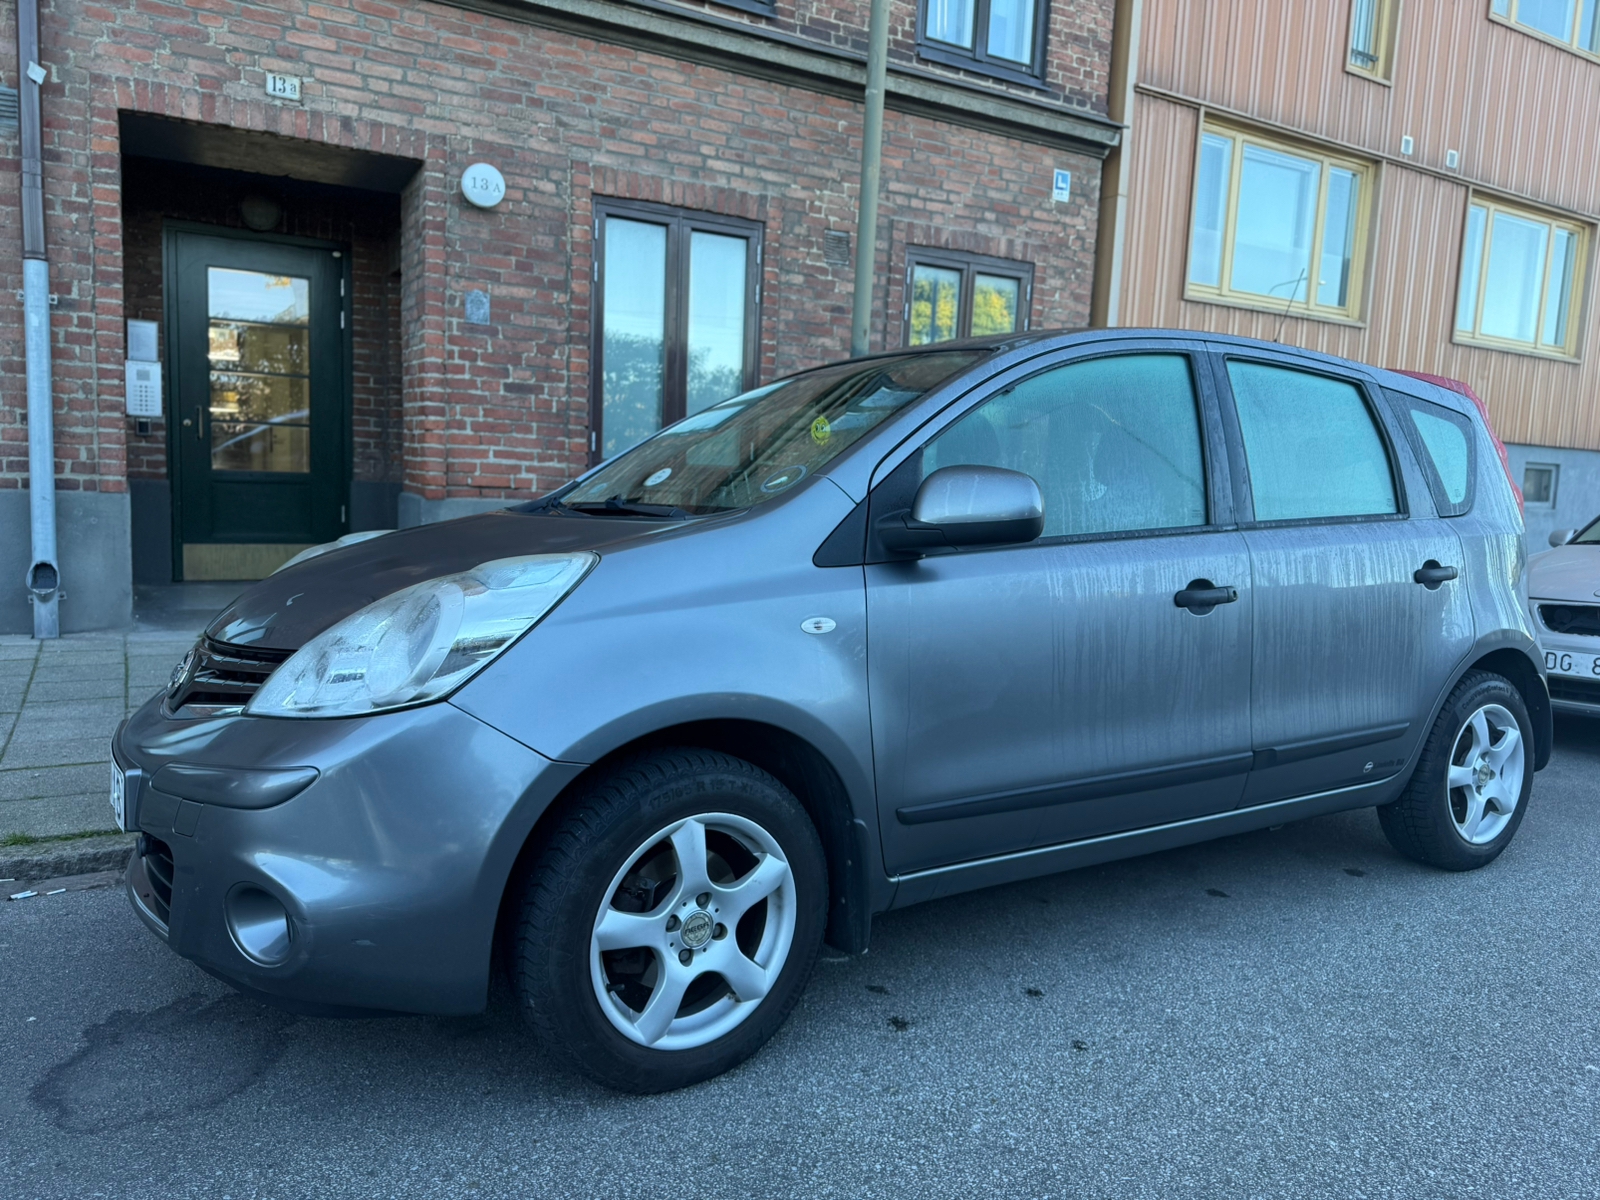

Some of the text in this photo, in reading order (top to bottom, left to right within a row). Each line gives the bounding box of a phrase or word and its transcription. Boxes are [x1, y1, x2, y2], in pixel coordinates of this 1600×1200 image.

[1057, 174, 1067, 188] L
[1591, 657, 1600, 675] 8
[696, 780, 706, 792] R
